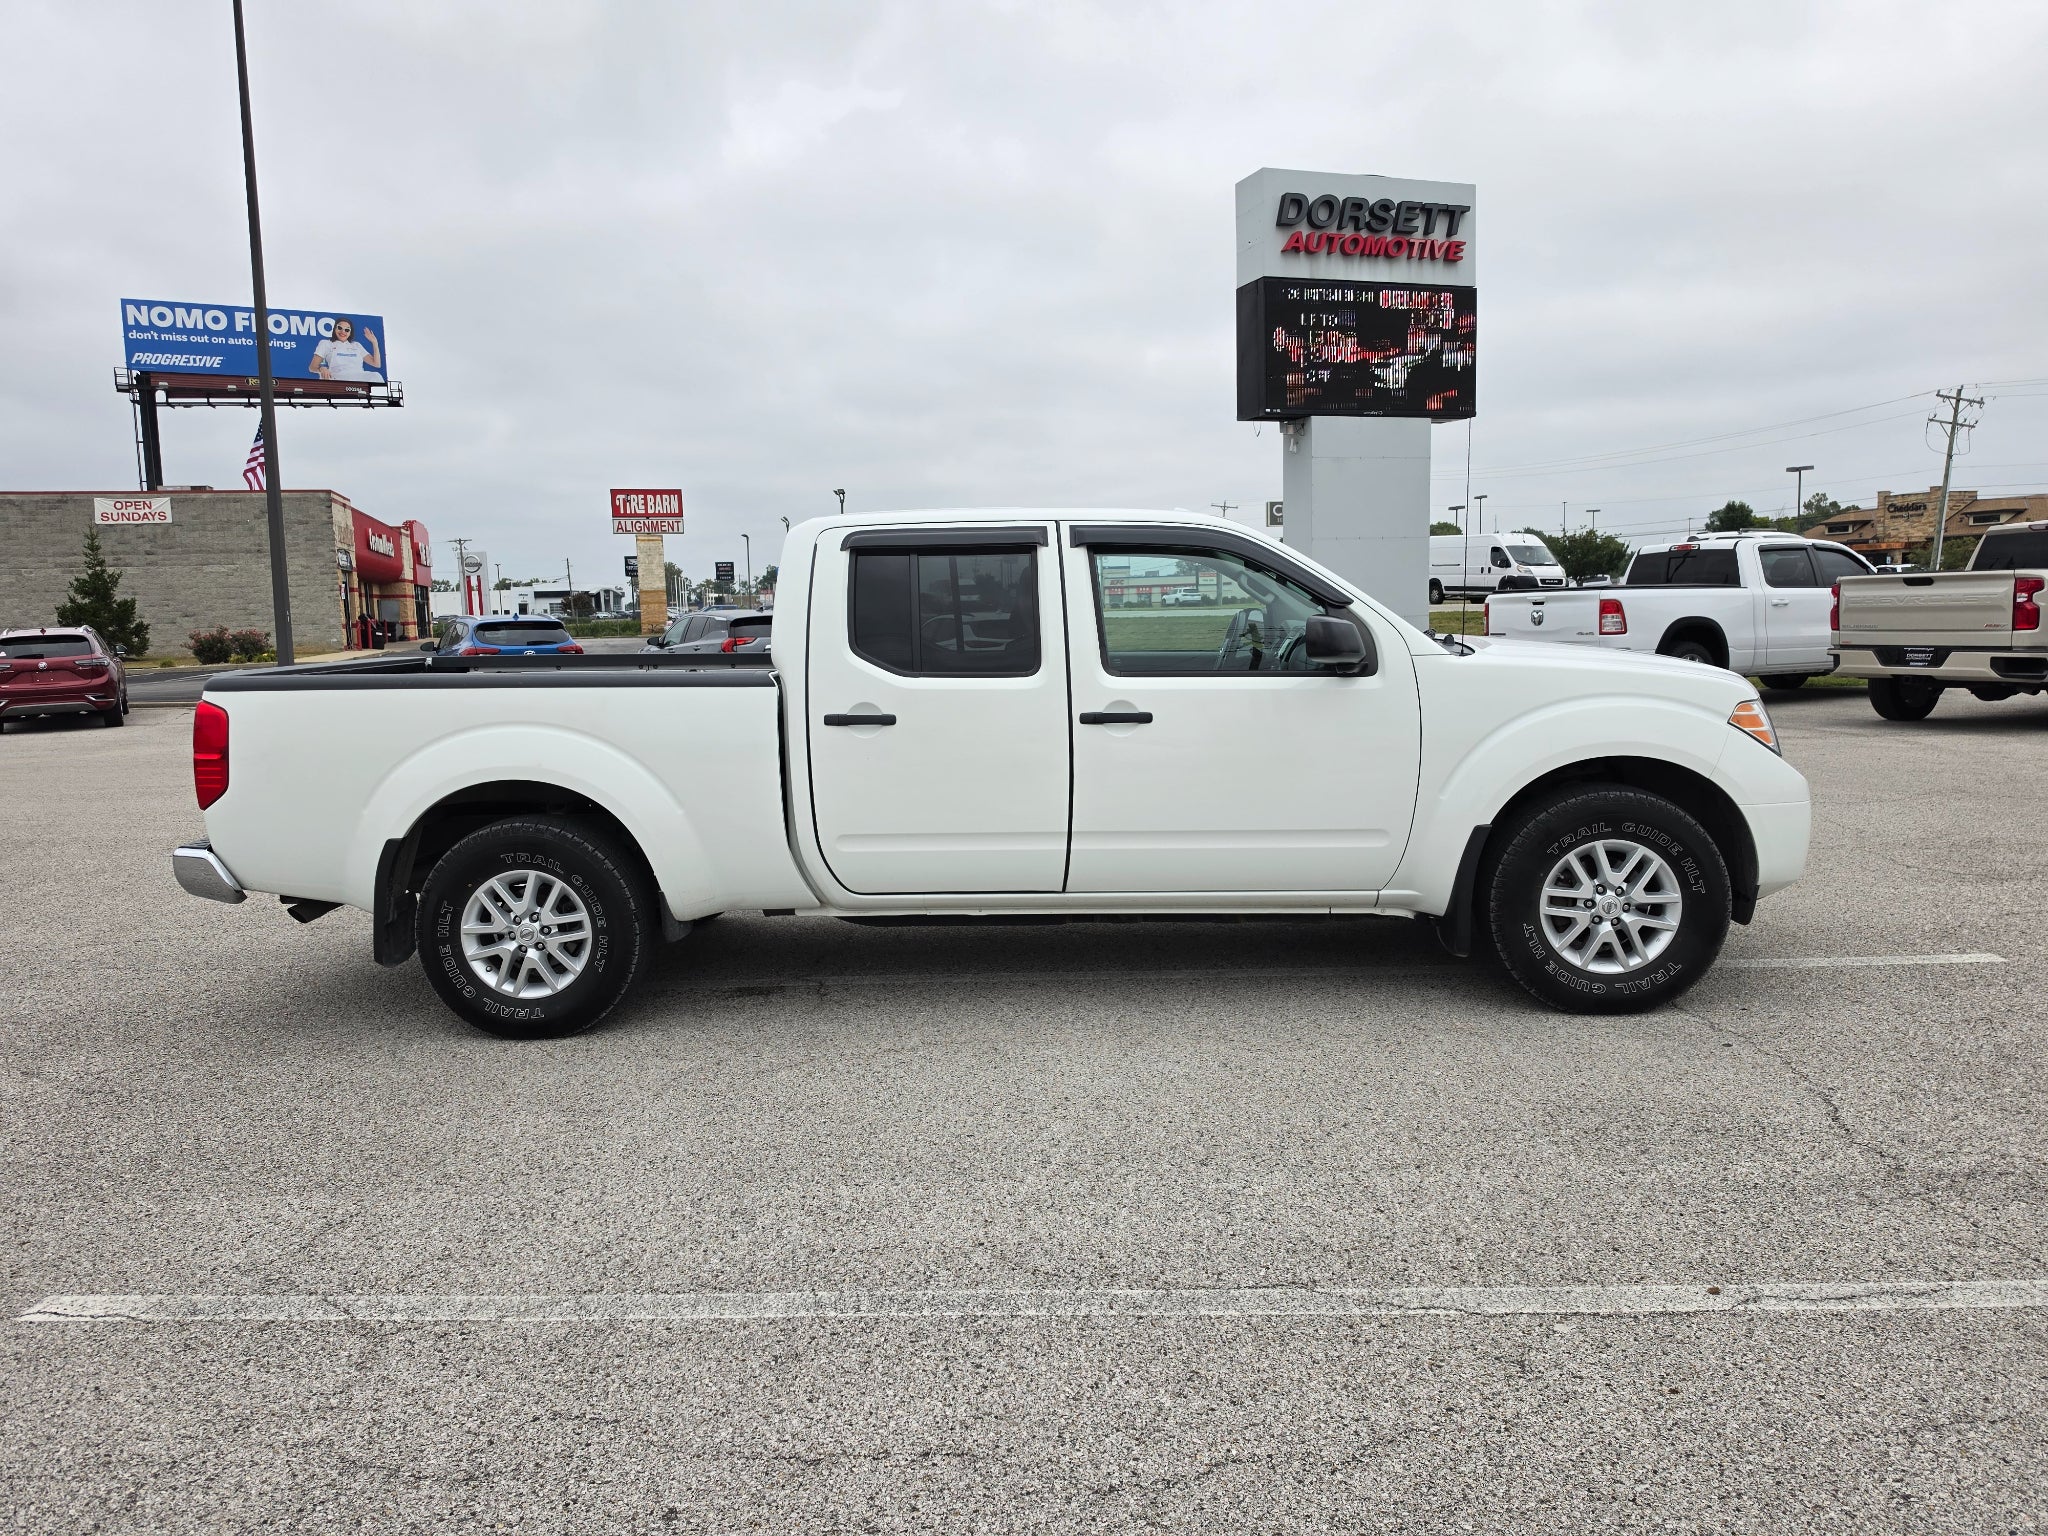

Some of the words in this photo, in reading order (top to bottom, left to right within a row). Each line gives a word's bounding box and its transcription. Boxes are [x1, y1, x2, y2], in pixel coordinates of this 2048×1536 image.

[1276, 192, 1471, 238] DORSETT
[1281, 231, 1466, 262] AUTOMOTIVE
[125, 304, 228, 331] NOMO
[128, 330, 159, 340] don't
[161, 332, 188, 342] miss
[190, 334, 210, 343] out
[211, 336, 226, 344] on
[228, 337, 254, 346] auto
[131, 352, 224, 368] PROGRESSIVE
[100, 511, 168, 522] SUNDAYS
[113, 500, 153, 511] OPEN
[615, 494, 646, 514] TIRE
[647, 494, 679, 514] BARN
[616, 520, 682, 533] ALIGNMENT
[1547, 822, 1612, 856] TRAIL
[1621, 822, 1683, 856] GUIDE
[1680, 857, 1706, 894] HLT
[437, 900, 454, 937] HLT
[500, 852, 564, 874] TRAIL
[571, 874, 607, 928] GUIDE
[594, 935, 609, 973] HLT
[1522, 923, 1547, 960] HLT
[438, 944, 476, 998] GUIDE
[1544, 960, 1607, 995] GUIDE
[1614, 961, 1682, 995] TRAIL
[482, 997, 545, 1020] TRAIL
